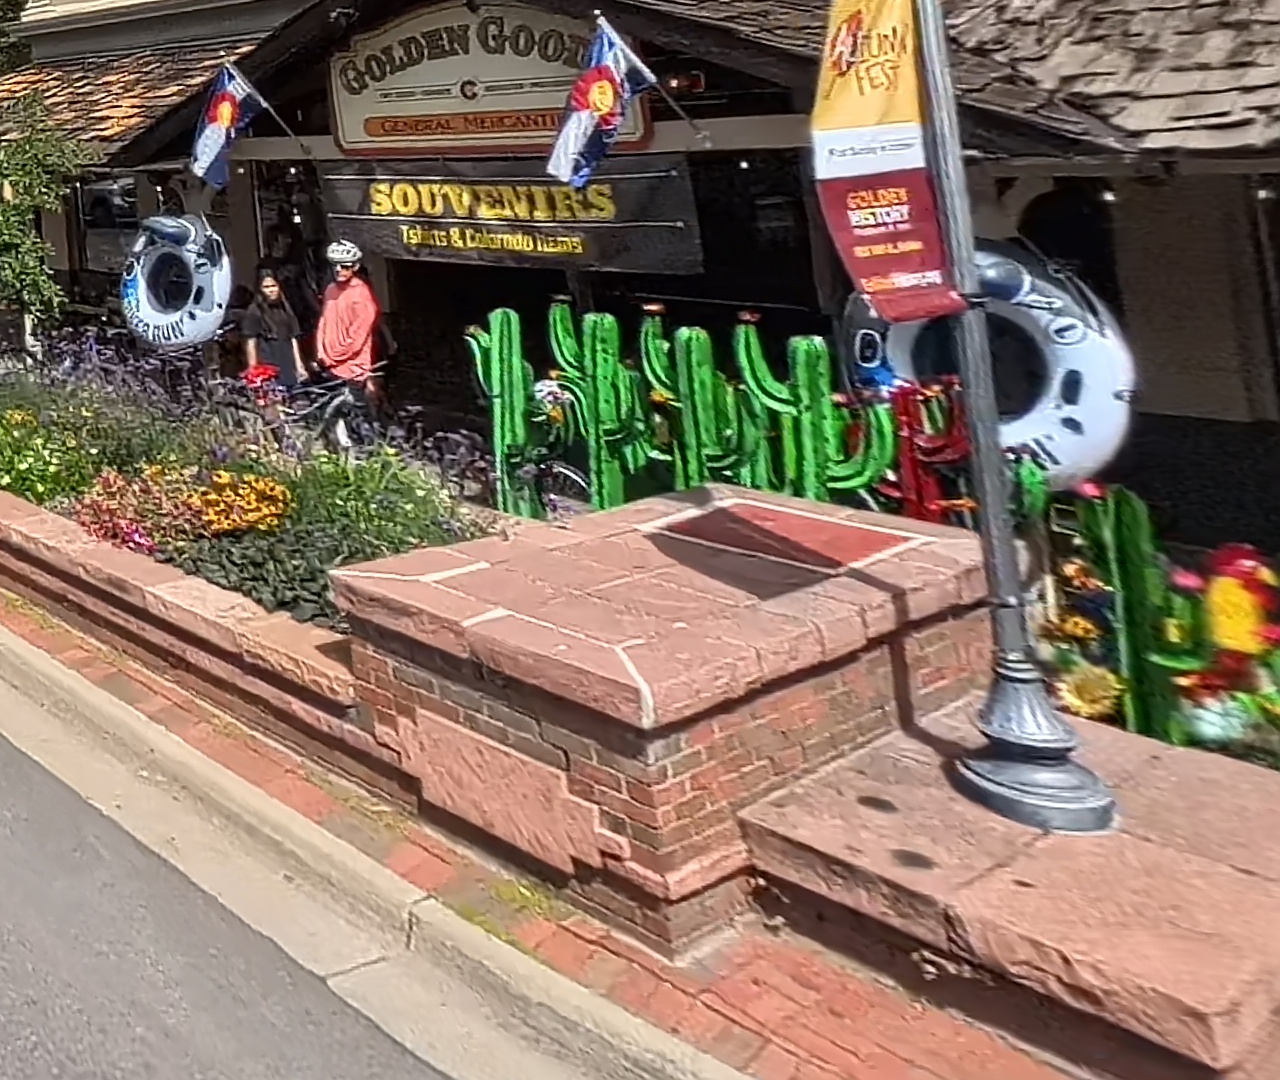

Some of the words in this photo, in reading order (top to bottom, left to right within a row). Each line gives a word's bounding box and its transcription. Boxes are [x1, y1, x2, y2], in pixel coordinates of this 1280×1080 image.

[340, 23, 471, 96] GOLDEN
[476, 15, 591, 70] GOOD
[854, 62, 900, 96] FEST
[380, 118, 454, 133] GENERAL
[463, 113, 559, 132] MERCANTI
[369, 181, 616, 220] SOUVENIRS
[449, 227, 464, 248] &
